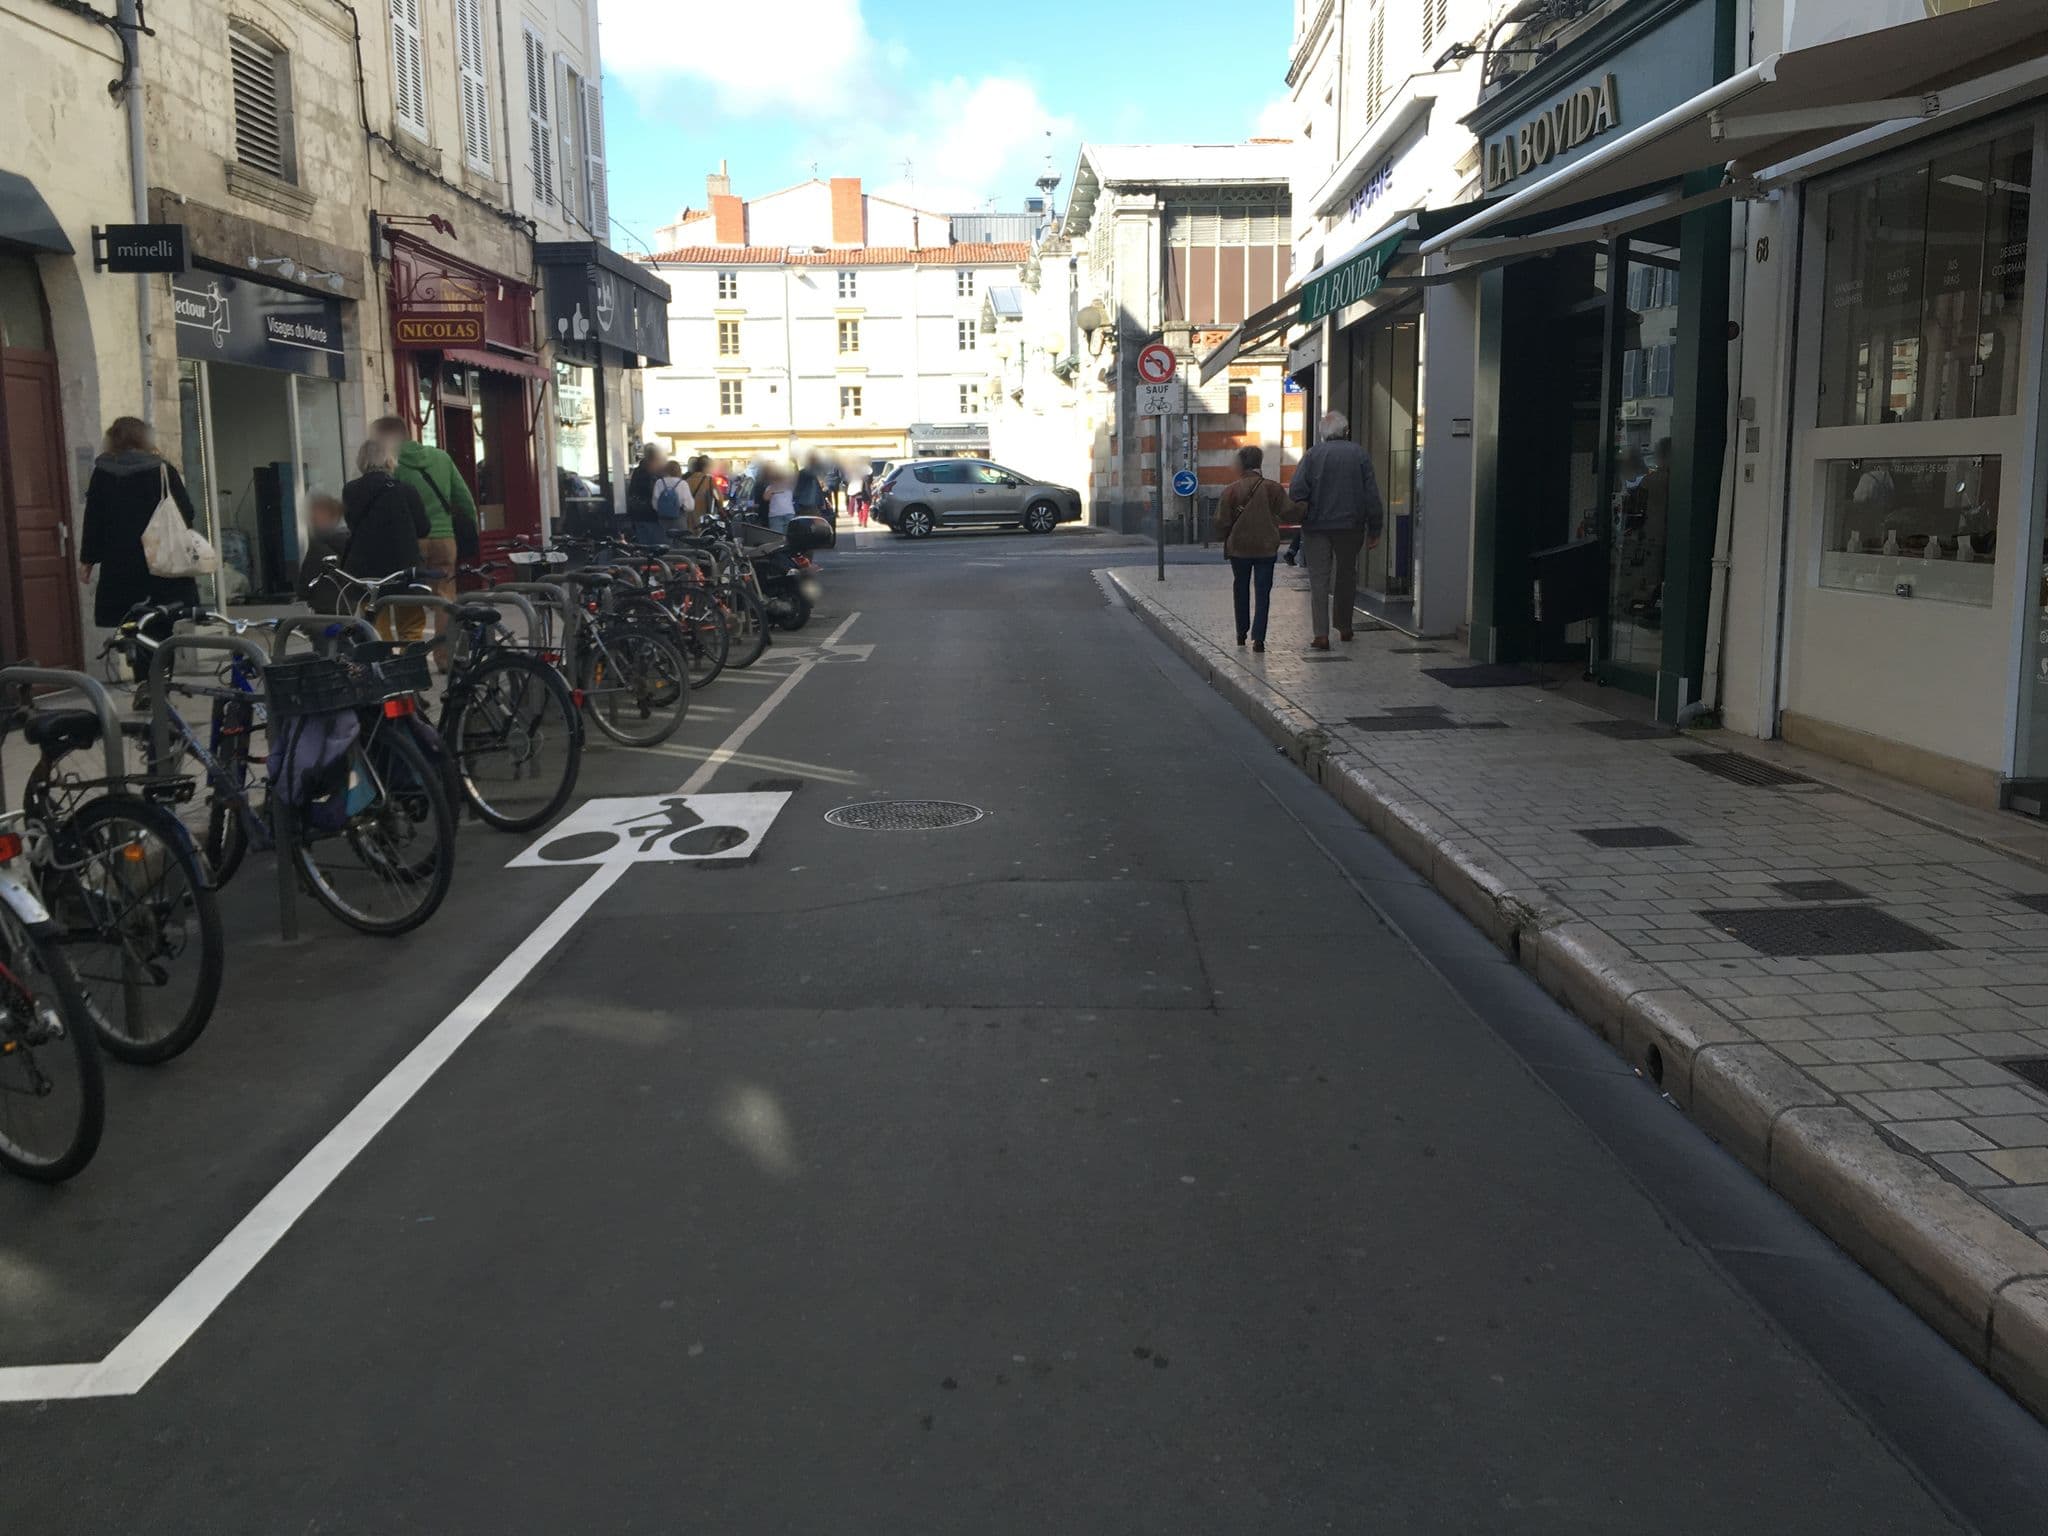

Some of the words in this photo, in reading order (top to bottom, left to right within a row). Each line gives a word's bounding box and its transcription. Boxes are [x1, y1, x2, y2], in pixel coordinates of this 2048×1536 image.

[1486, 135, 1514, 192] LA
[1517, 72, 1620, 175] BOVIDA
[117, 240, 172, 257] minelli
[1312, 283, 1327, 318] LA
[1329, 250, 1381, 311] BOVIDA
[267, 316, 294, 338] Visages
[295, 323, 304, 338] du
[305, 324, 327, 343] Monde
[403, 323, 475, 338] NICOLAS
[1145, 385, 1169, 394] SAUF
